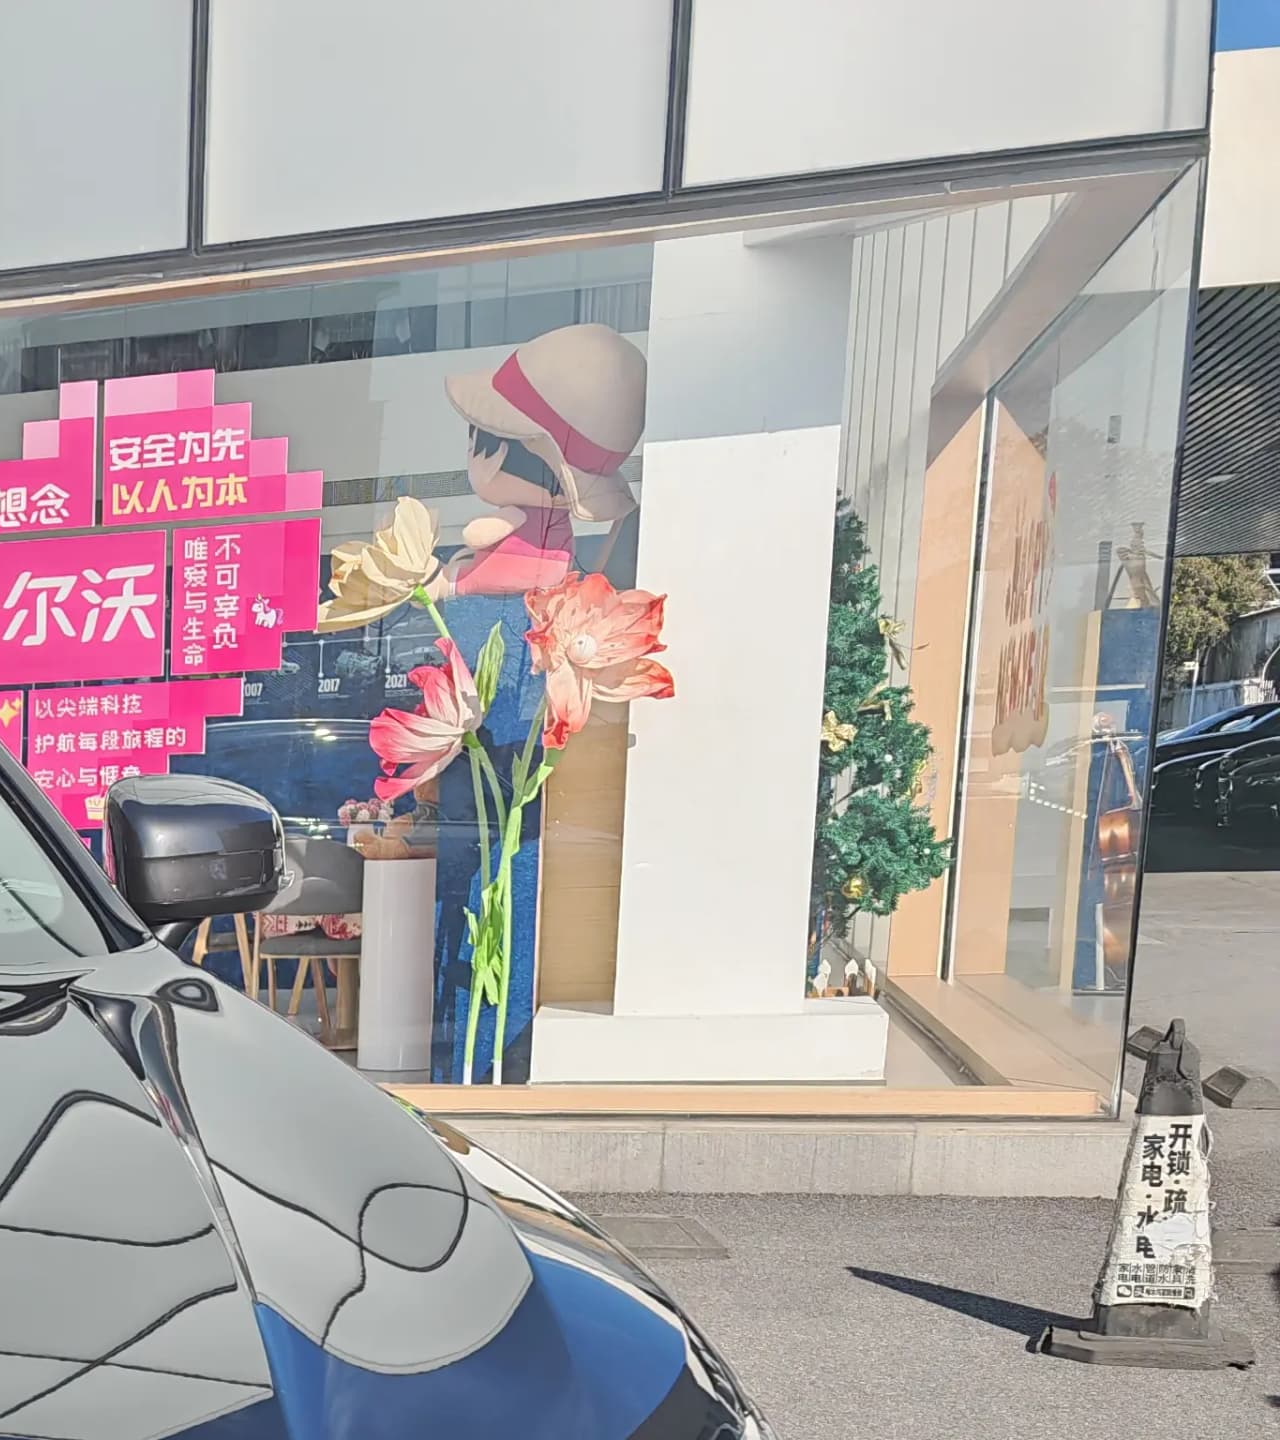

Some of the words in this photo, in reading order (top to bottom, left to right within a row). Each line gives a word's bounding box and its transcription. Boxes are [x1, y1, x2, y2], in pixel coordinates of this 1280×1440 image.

[109, 428, 245, 471] 安全为先
[111, 473, 248, 515] 以人为本
[182, 536, 208, 666] 唯爱与生命
[213, 534, 241, 649] 不可辜负
[244, 683, 263, 697] 007
[318, 678, 340, 693] 2017
[385, 674, 407, 689] 2021
[35, 694, 142, 719] 以尖端科技
[35, 727, 186, 754] 护航每段旅程的
